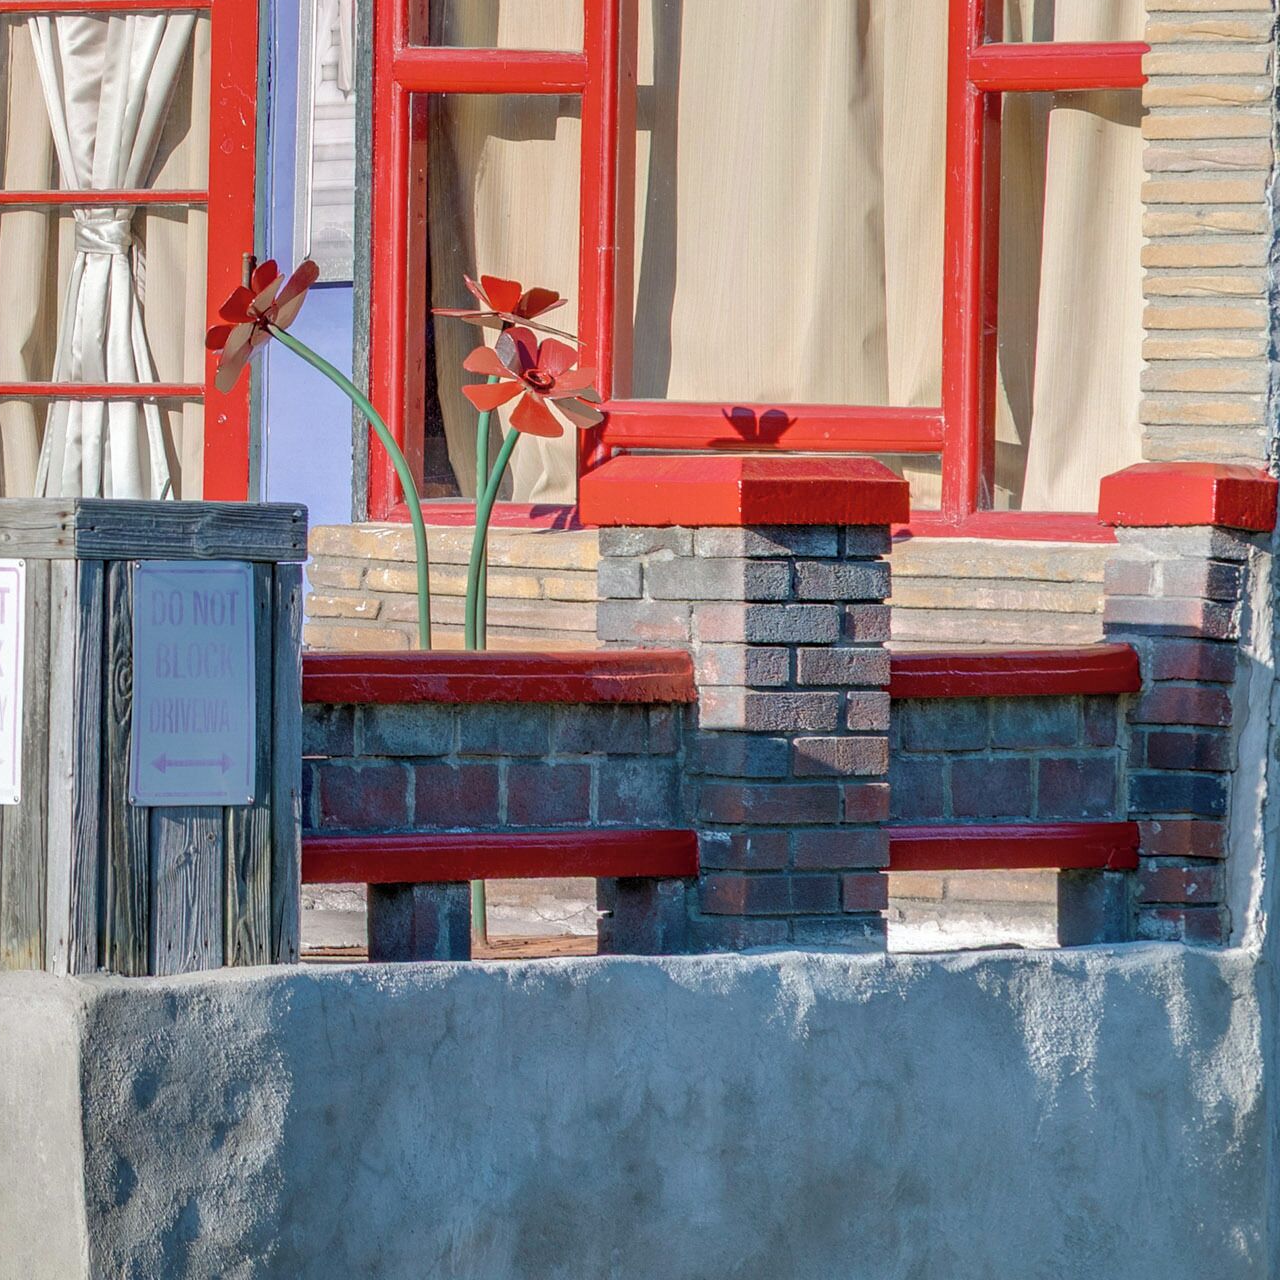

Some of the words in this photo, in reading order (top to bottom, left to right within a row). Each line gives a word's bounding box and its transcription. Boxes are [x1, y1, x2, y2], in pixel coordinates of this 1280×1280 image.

[151, 590, 183, 626] DO
[193, 590, 239, 626] NOT
[154, 642, 235, 679] BLOCK
[149, 697, 235, 734] DRIVEWA
